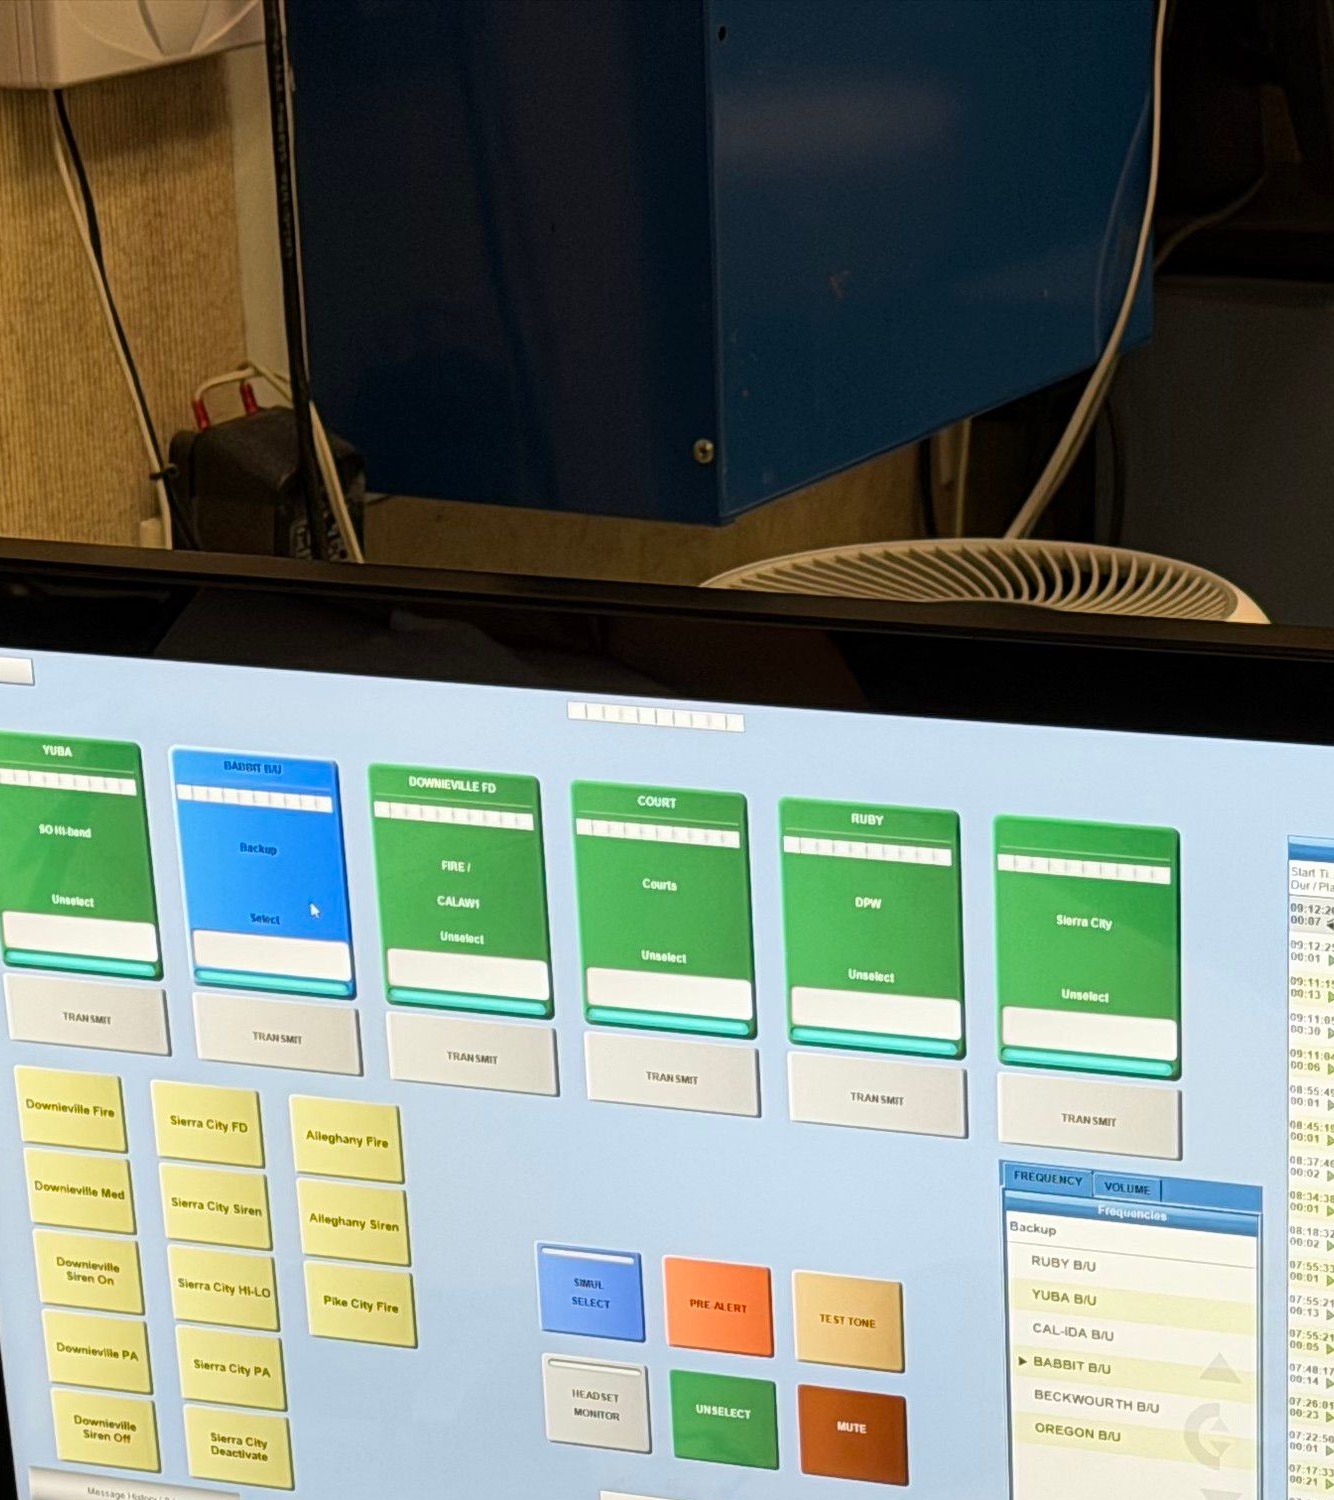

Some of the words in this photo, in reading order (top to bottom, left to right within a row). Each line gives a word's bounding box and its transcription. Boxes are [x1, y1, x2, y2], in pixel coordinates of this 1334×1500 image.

[42, 744, 73, 758] YUBA
[408, 775, 479, 793] DOWNIEVILLE
[481, 781, 497, 795] FD
[637, 794, 677, 810] COURT
[850, 812, 884, 827] RUBY
[239, 841, 278, 857] Backup
[441, 859, 465, 873] FIRE
[642, 878, 678, 892] Courts
[51, 893, 95, 909] Unselect
[855, 897, 882, 910] DPW
[249, 912, 281, 926] Select
[1056, 915, 1088, 930] Sierra
[1090, 916, 1113, 932] City
[439, 930, 485, 946] Unselect
[641, 949, 687, 964] Unselect
[848, 967, 895, 983] Unselect
[1061, 988, 1110, 1004] Unselect
[25, 1098, 91, 1117] Downieville
[92, 1106, 116, 1119] Fire
[169, 1114, 204, 1130] Sierra
[205, 1118, 229, 1134] City
[231, 1121, 248, 1134] FD
[305, 1129, 363, 1149] Alleghany
[365, 1136, 389, 1150] Fire
[34, 1180, 99, 1199] Downieville
[100, 1187, 126, 1201] Med
[1013, 1169, 1083, 1188] FREQUENCY
[1104, 1181, 1151, 1197] VOLUME
[170, 1196, 205, 1212] Sierra
[206, 1200, 231, 1216] City
[232, 1203, 263, 1218] Siren
[1097, 1204, 1168, 1223] Frequencies
[308, 1212, 367, 1232] Alleghany
[369, 1219, 400, 1233] Siren
[1009, 1219, 1057, 1238] Backup
[55, 1256, 121, 1275] Downieville
[1031, 1255, 1069, 1271] RUBY
[1072, 1259, 1097, 1274] B/U
[66, 1270, 96, 1285] Siren
[96, 1273, 115, 1287] On
[177, 1277, 211, 1292] Sierra
[213, 1281, 236, 1297] City
[573, 1277, 605, 1291] SIMUL
[323, 1294, 349, 1309] Pike
[350, 1297, 375, 1313] City
[376, 1301, 399, 1315] Fire
[571, 1295, 611, 1310] SELECT
[1031, 1288, 1070, 1304] YUBA
[1073, 1293, 1098, 1307] B/U
[689, 1298, 712, 1312] PRE
[713, 1300, 748, 1315] ALERT
[818, 1312, 846, 1326] TEST
[847, 1315, 877, 1329] TONE
[1090, 1328, 1115, 1342] B/U
[55, 1342, 120, 1361] Downieville
[121, 1348, 139, 1362] PA
[193, 1359, 227, 1375] Sierra
[228, 1363, 252, 1378] City
[253, 1366, 271, 1379] PA
[1033, 1356, 1085, 1373] BABBIT
[1088, 1361, 1112, 1376] B/U
[571, 1388, 620, 1404] HEADSET
[1034, 1389, 1134, 1411] BECKWOURTH
[1136, 1400, 1161, 1415] B/U
[573, 1406, 621, 1422] MONITOR
[695, 1403, 752, 1421] UNSELECT
[73, 1414, 137, 1433] Downieville
[836, 1420, 868, 1435] MUTE
[1034, 1421, 1095, 1440] OREGON
[1097, 1427, 1122, 1443] B/U
[82, 1428, 112, 1443] Siren
[113, 1431, 132, 1445] Off
[209, 1431, 244, 1447] Sierra
[245, 1435, 268, 1451] City
[210, 1445, 269, 1463] Deactivate
[87, 1486, 126, 1500] Message
